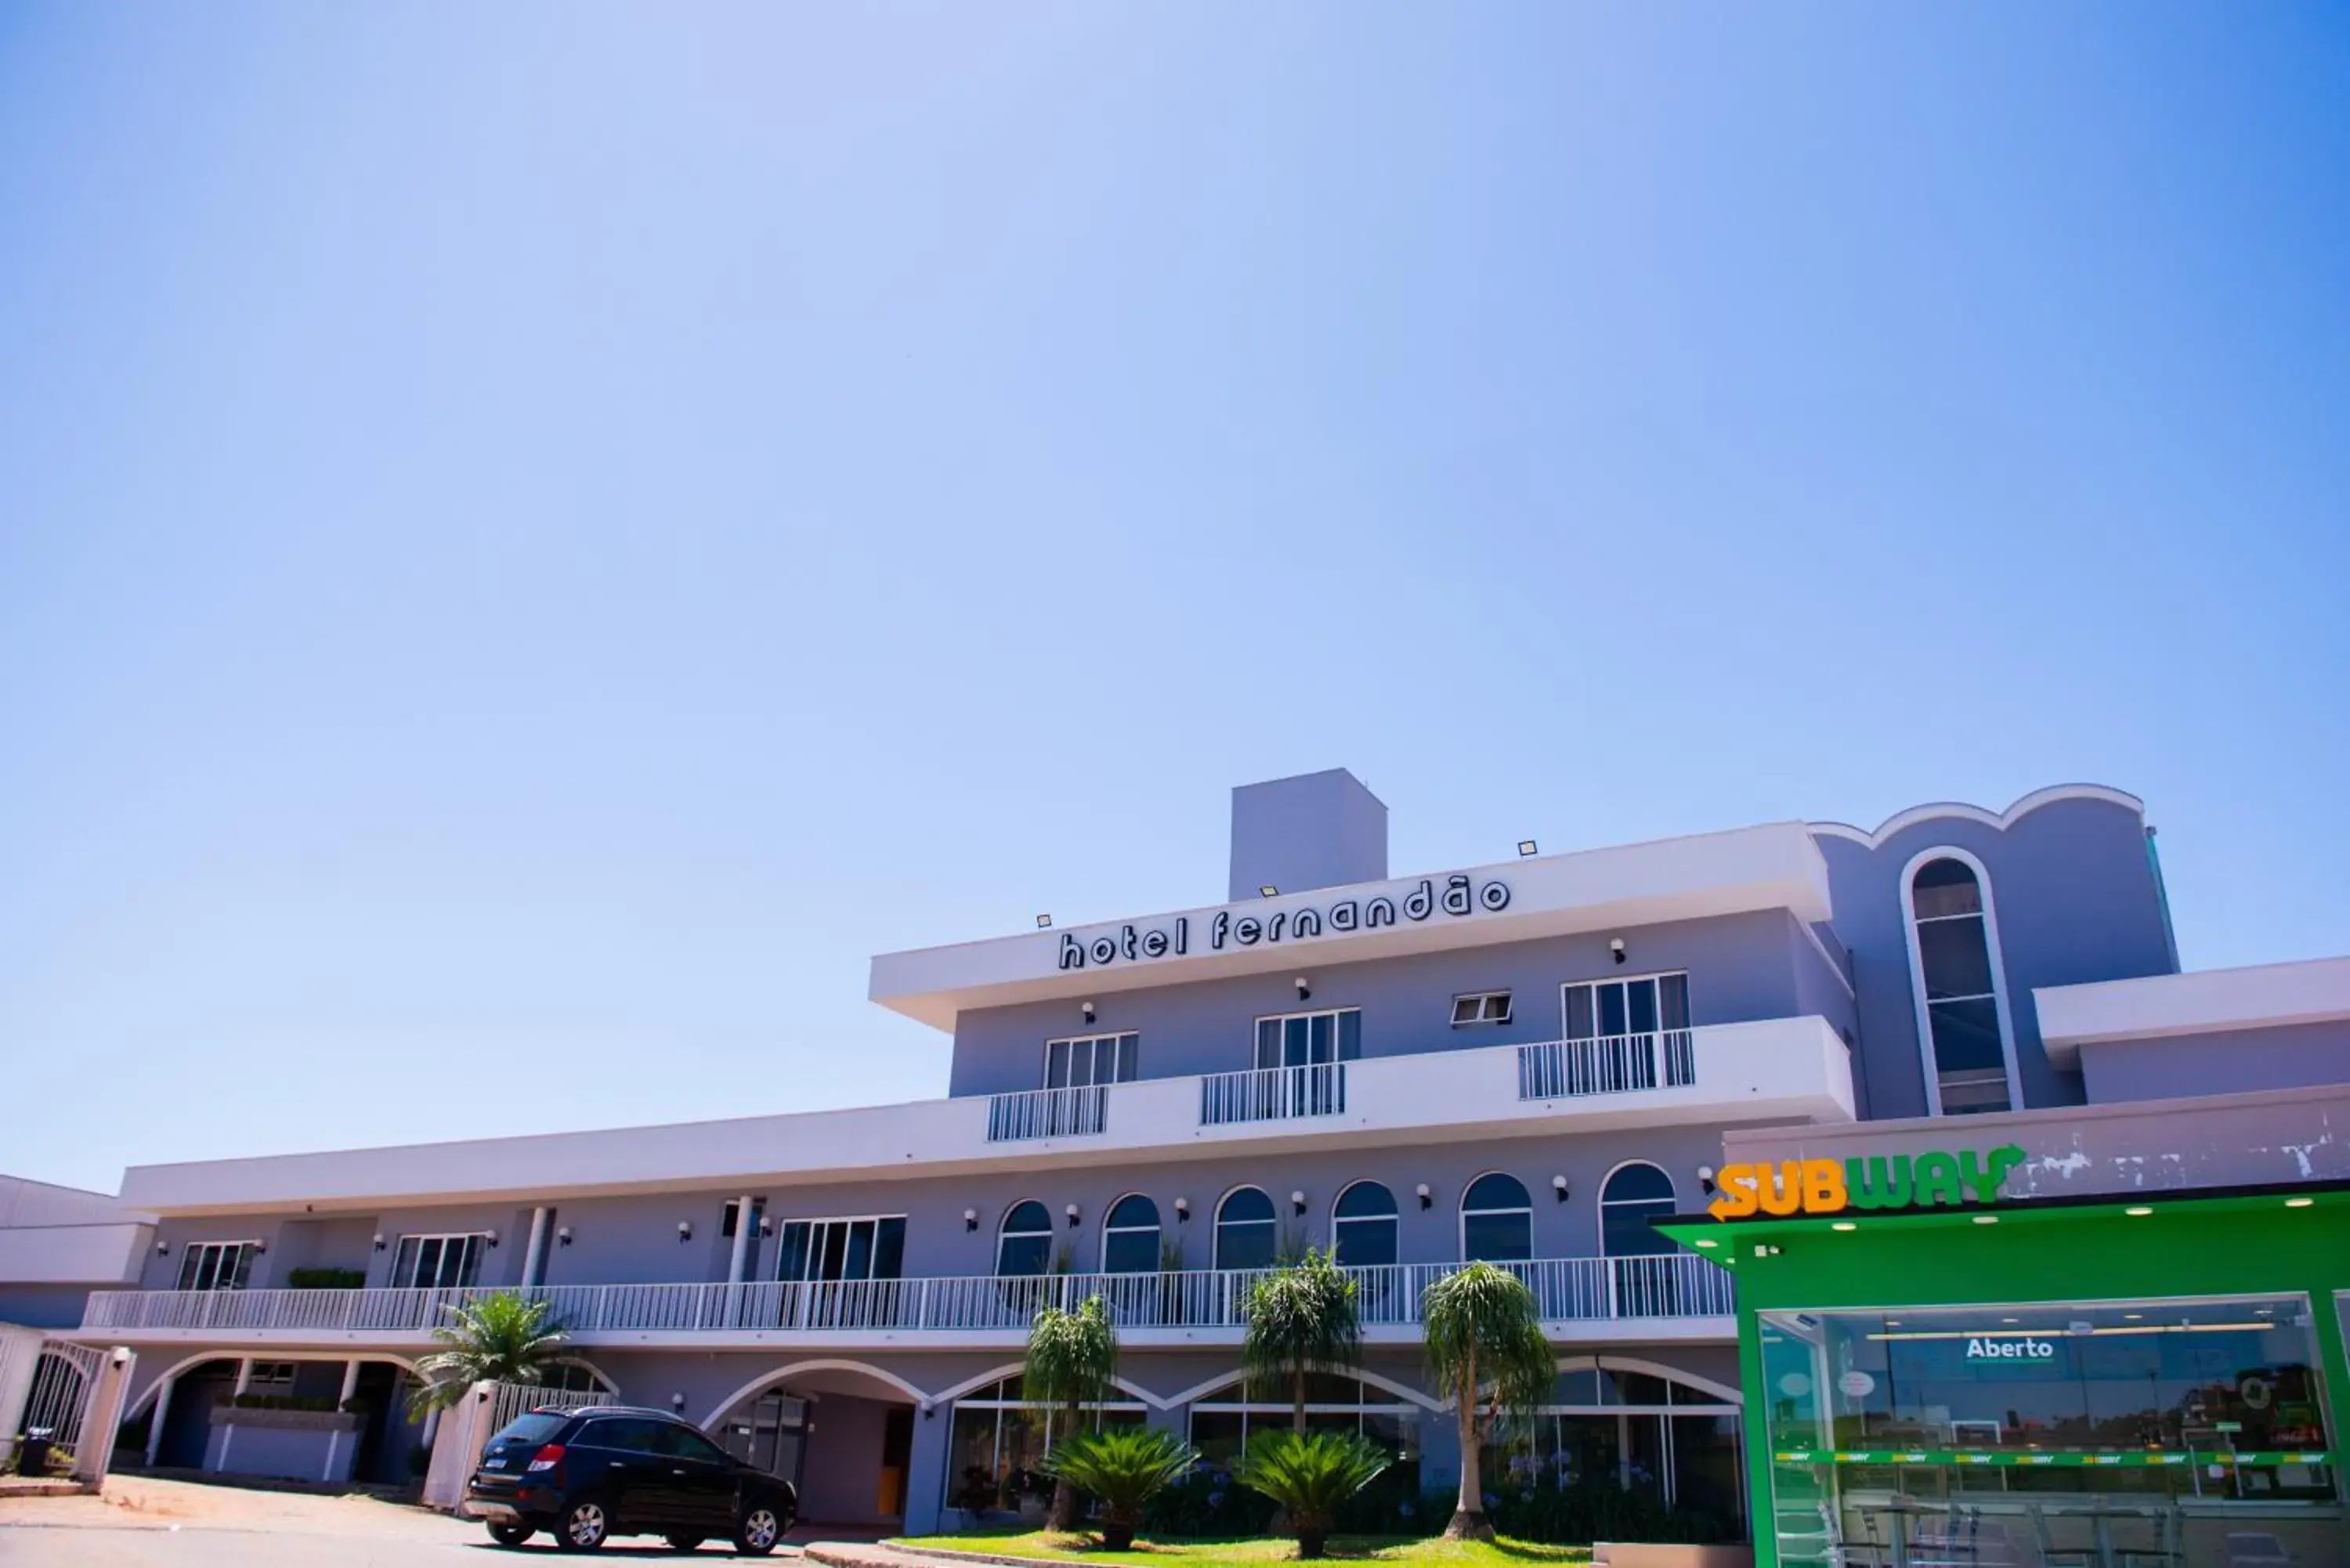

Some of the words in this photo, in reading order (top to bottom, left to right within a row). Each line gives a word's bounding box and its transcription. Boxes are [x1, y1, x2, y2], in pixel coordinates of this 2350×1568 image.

[1058, 917, 1188, 969] hotel
[1212, 875, 1510, 949] fernandão
[1708, 1143, 2027, 1222] SUBWAY
[1966, 1337, 2054, 1357] Aberto
